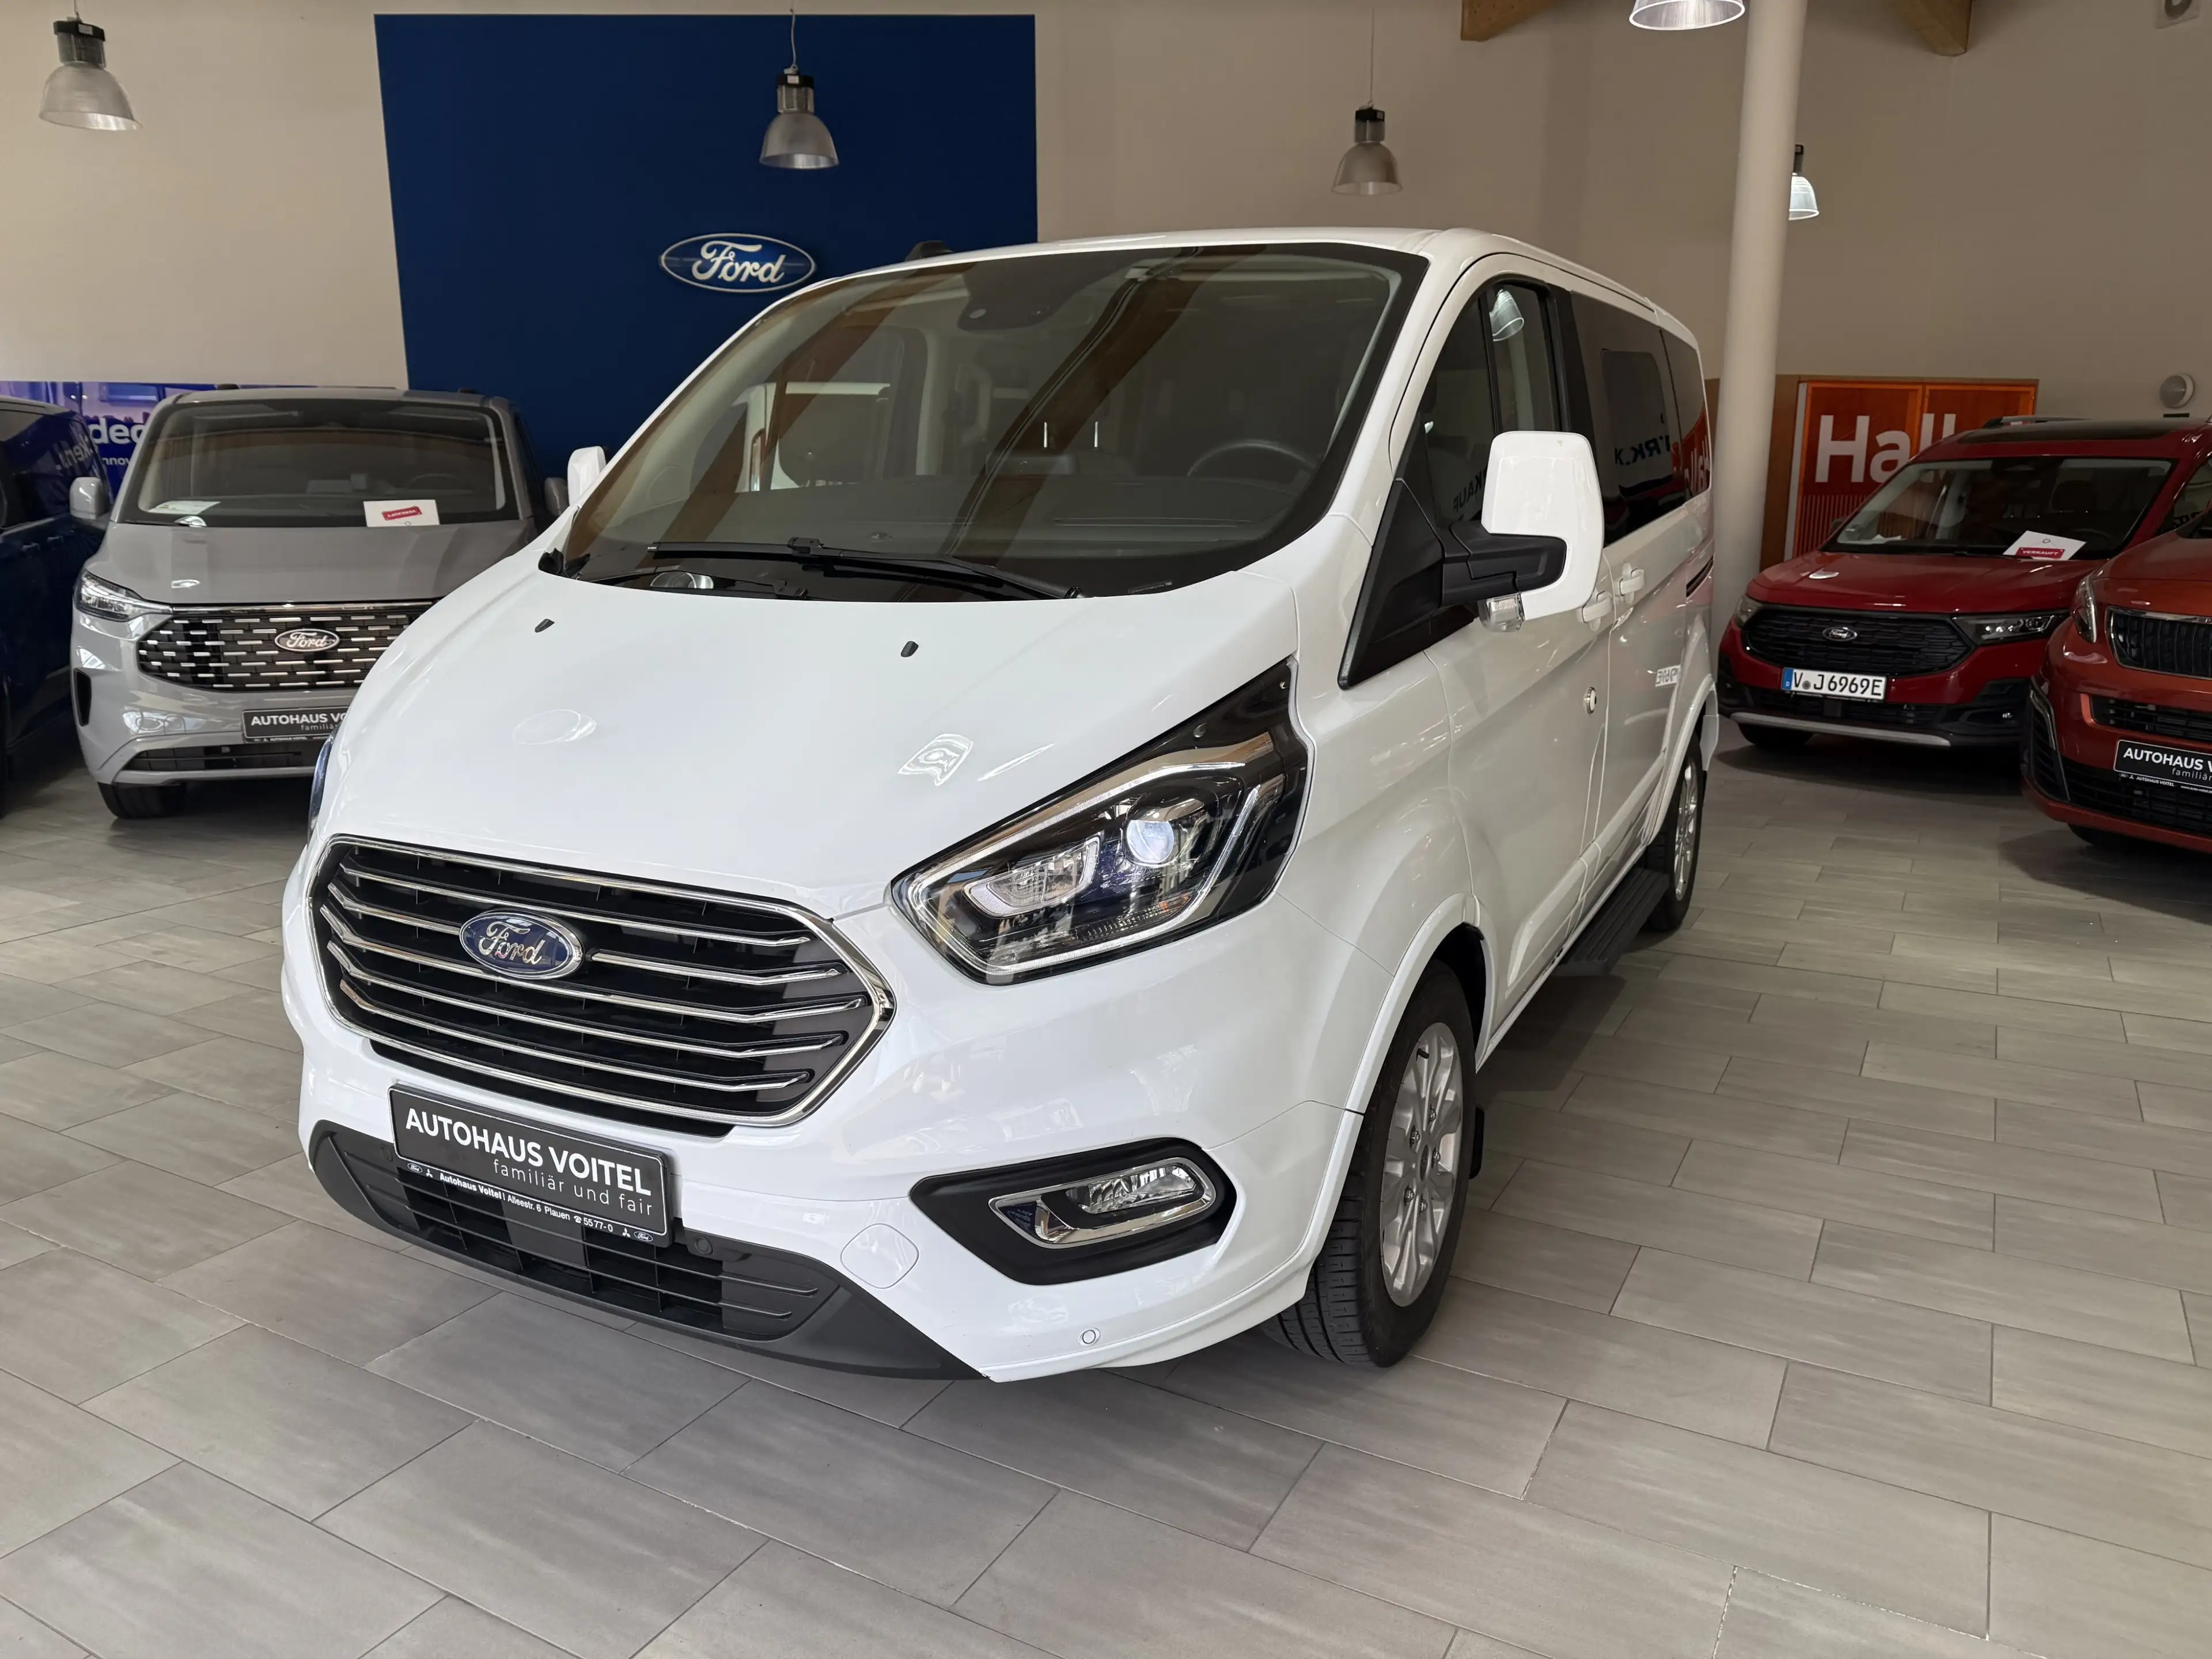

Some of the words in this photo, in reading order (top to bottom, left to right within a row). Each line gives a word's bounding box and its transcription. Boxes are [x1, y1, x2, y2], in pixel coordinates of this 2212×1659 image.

[692, 240, 787, 283] Ford
[286, 631, 328, 648] Ford
[1794, 672, 1804, 688] V
[1814, 674, 1825, 690] J
[1828, 675, 1883, 696] 6969E
[251, 713, 328, 726] AUTOHAUS
[2123, 747, 2203, 771] AUTOHAUS
[2136, 776, 2159, 784] AUTOHAUS
[478, 921, 546, 965] Ford
[406, 1108, 543, 1167] AUTOHAUS
[548, 1146, 652, 1196] VOITEL
[440, 1172, 478, 1191] Autohaus
[507, 1194, 535, 1210] Alleestr.
[536, 1203, 541, 1213] 6
[544, 1206, 571, 1221] Plauen
[493, 1159, 564, 1192] familiär
[574, 1184, 609, 1205] und
[619, 1194, 653, 1215] fair
